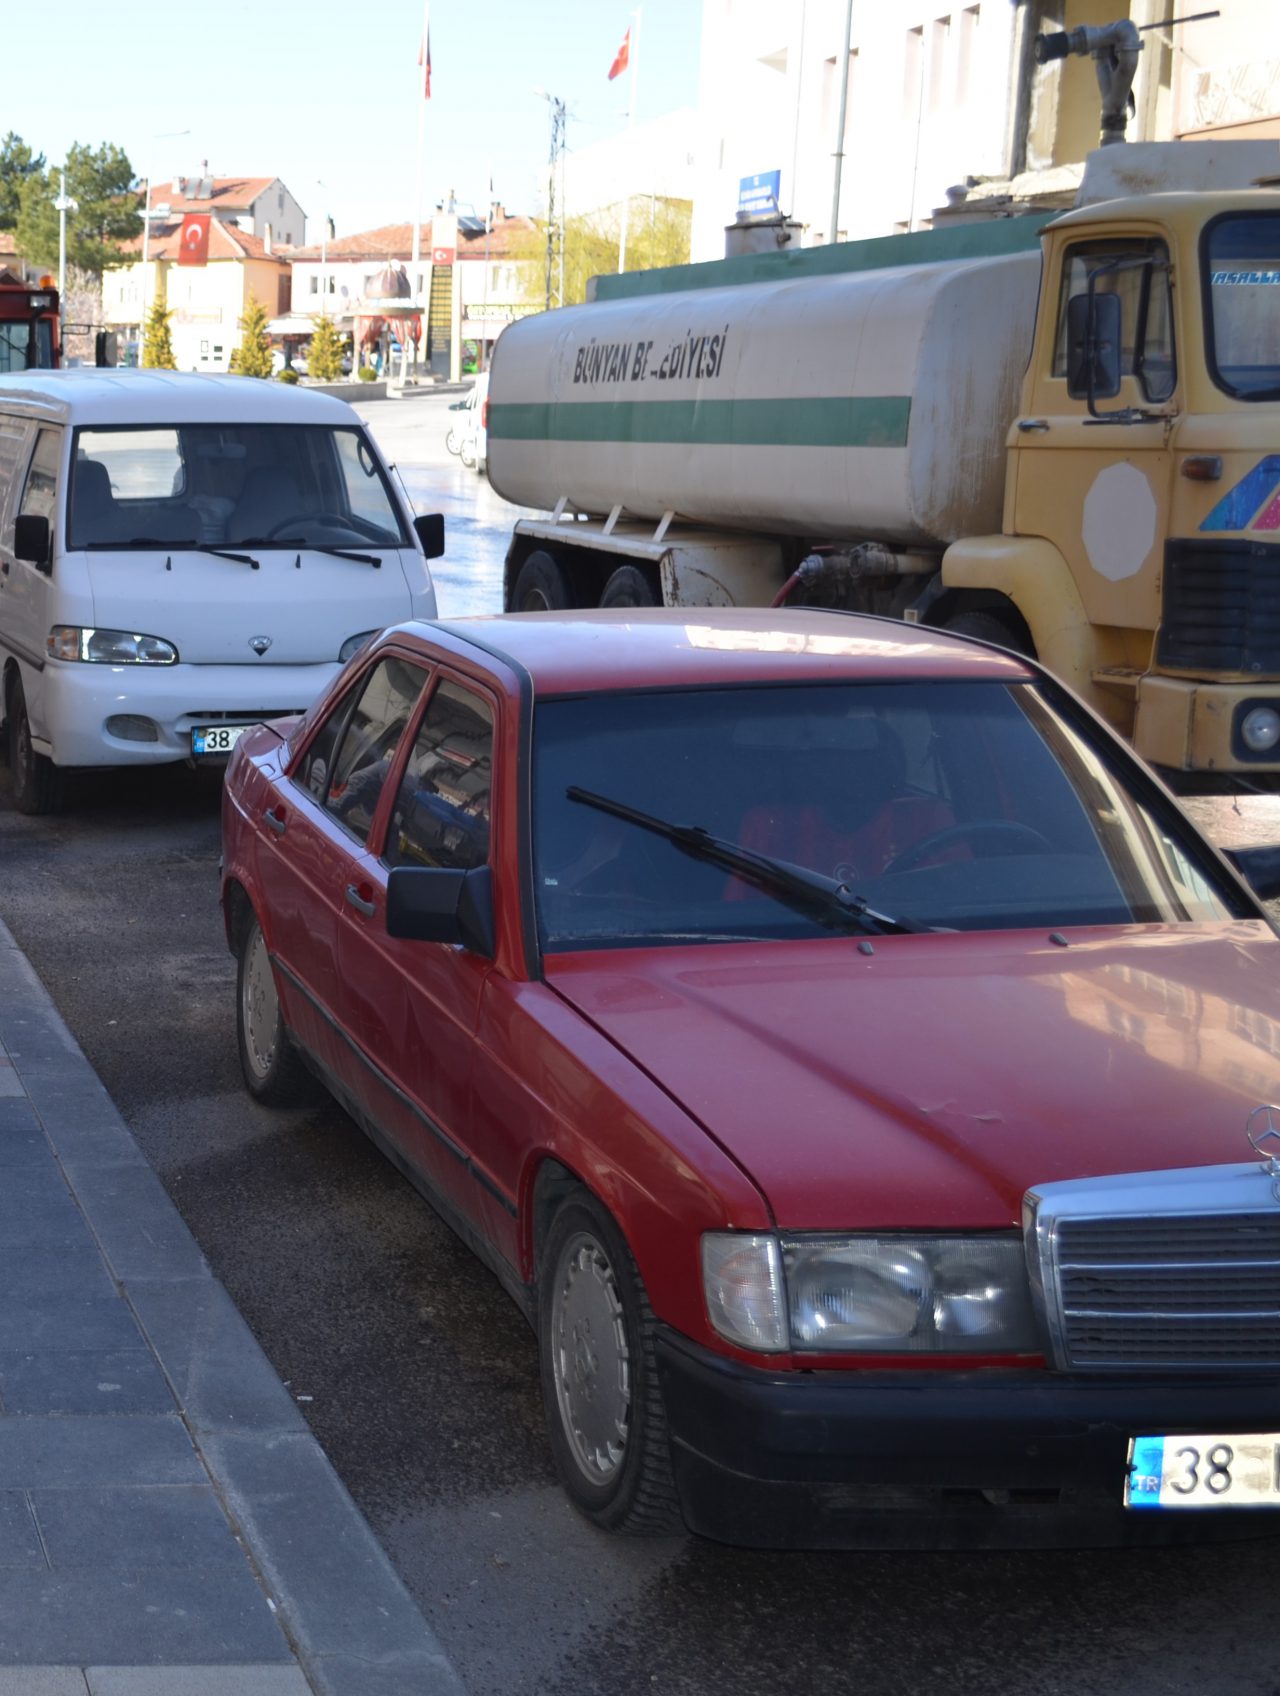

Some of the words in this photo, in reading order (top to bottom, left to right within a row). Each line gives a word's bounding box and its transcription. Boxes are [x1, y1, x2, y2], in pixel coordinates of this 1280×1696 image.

[573, 337, 632, 384] BÜNYAN
[631, 324, 729, 381] BEEDİYESİ
[207, 730, 230, 749] 38
[1134, 1475, 1159, 1491] TR
[1171, 1442, 1234, 1495] 38
